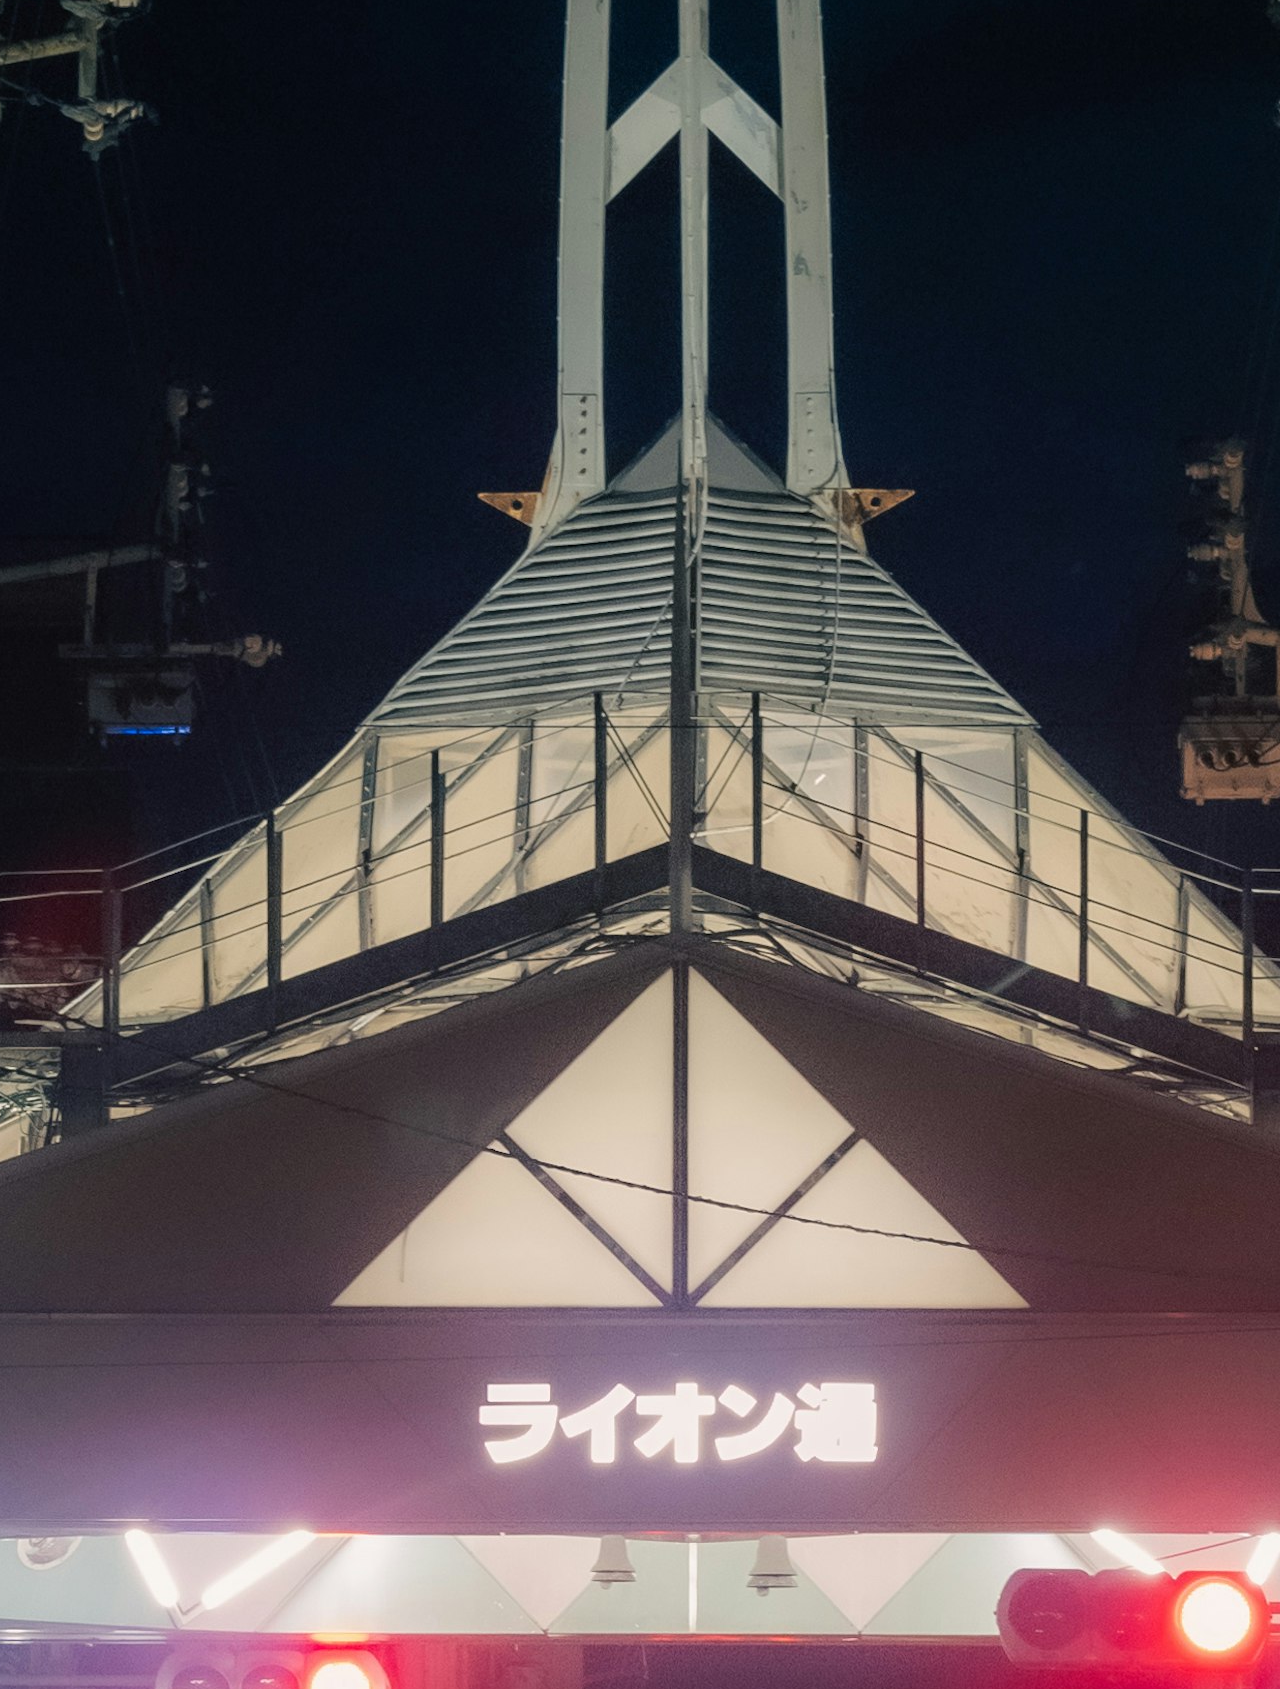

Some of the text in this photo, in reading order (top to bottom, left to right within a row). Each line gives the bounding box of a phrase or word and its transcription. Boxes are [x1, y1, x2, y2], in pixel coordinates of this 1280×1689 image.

[478, 1382, 880, 1464] ライオン通
